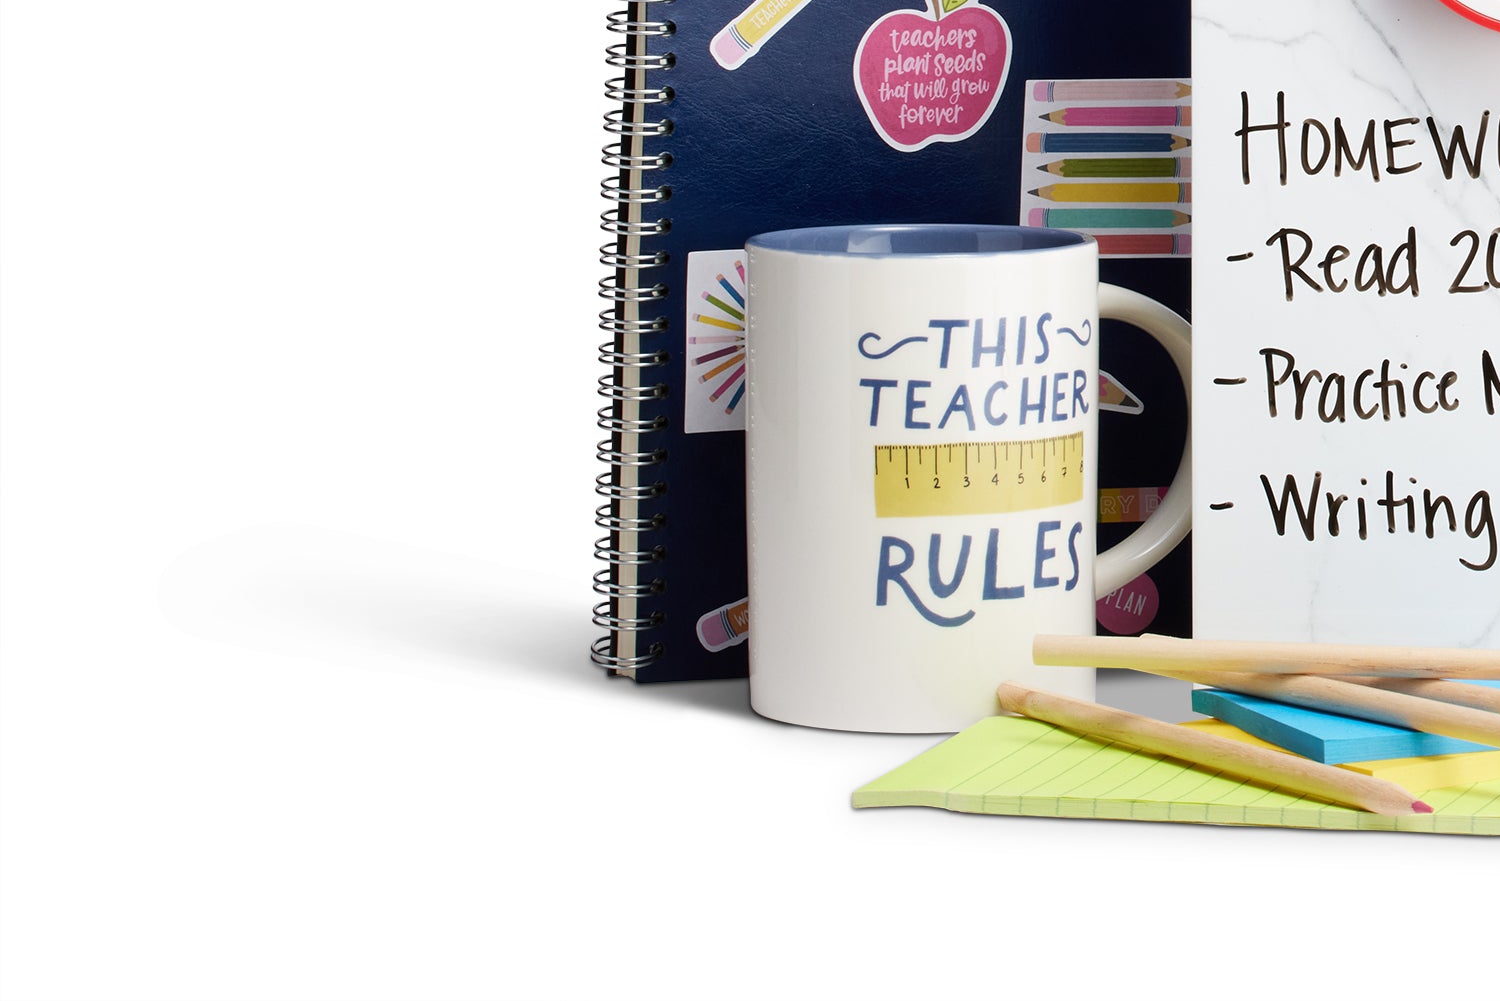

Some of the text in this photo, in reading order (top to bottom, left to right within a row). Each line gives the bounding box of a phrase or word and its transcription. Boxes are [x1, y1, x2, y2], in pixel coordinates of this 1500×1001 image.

[889, 26, 978, 53] teachers
[884, 52, 932, 82] plant
[878, 77, 990, 105] that will grow
[898, 103, 964, 129] forever
[1265, 226, 1419, 301] Read
[928, 312, 1053, 370] THIS
[858, 369, 1090, 431] TEACHER
[1258, 347, 1459, 423] Practice
[933, 477, 941, 489] 2
[963, 476, 971, 488] 3
[991, 473, 1000, 486] 4
[1017, 472, 1025, 485] 5
[1041, 470, 1047, 483] 6
[1259, 470, 1498, 571] Writing
[875, 520, 1083, 627] RULES
[1105, 588, 1147, 616] PLAN
